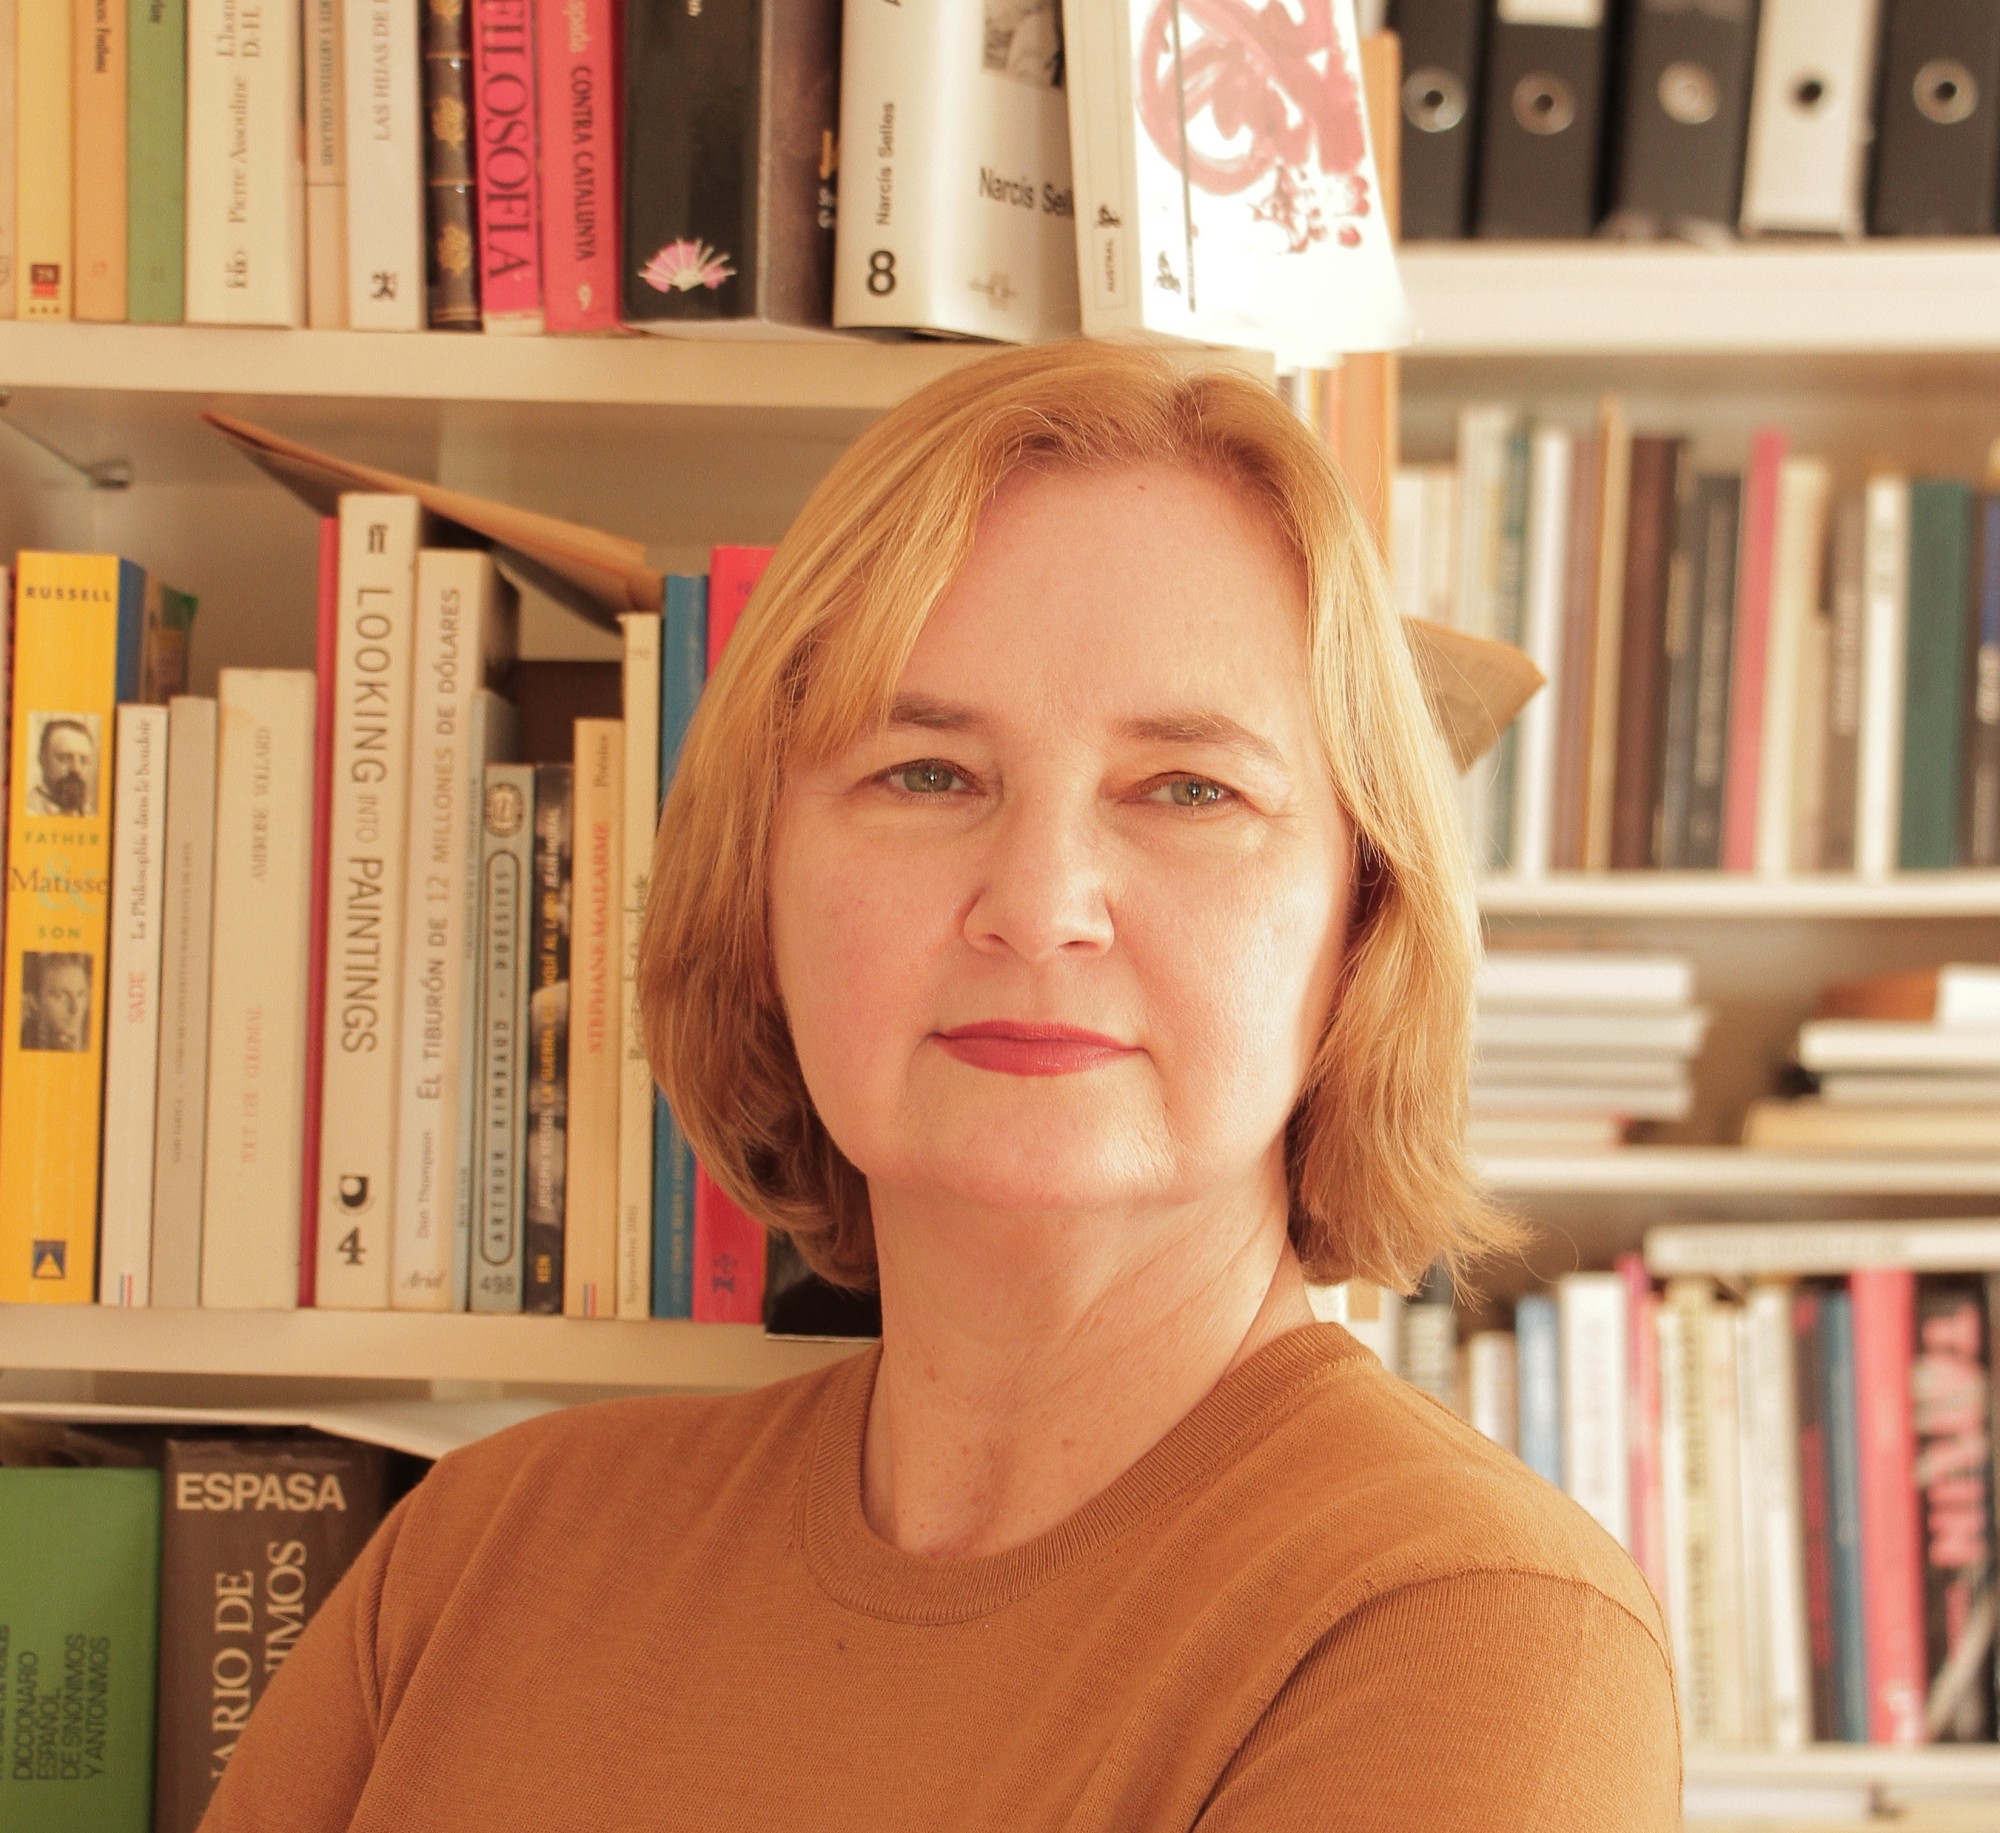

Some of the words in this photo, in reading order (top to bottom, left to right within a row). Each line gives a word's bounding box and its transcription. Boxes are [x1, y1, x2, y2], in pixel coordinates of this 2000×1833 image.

[371, 9, 389, 37] DE
[372, 44, 390, 98] HIJAS
[373, 105, 391, 141] LAS
[571, 65, 594, 145] CONTRA
[480, 0, 532, 278] FILOSOFIA
[227, 169, 249, 224] Pierre
[572, 152, 598, 262] CATALUNYA
[867, 248, 896, 296] 8
[25, 586, 113, 603] RUSSELL
[432, 588, 461, 694] DÓLARES
[353, 588, 392, 784] LOOKING
[436, 705, 457, 736] DE
[133, 718, 152, 777] boudoir
[132, 796, 150, 830] dans
[357, 794, 380, 844] INTO
[431, 747, 455, 863] MILLONES
[24, 831, 100, 846] FATHER
[10, 865, 107, 896] Matisse
[129, 834, 153, 917] Philosophie
[425, 875, 450, 903] 12
[544, 853, 561, 888] JEAN
[37, 926, 81, 939] SON
[129, 921, 147, 941] La
[341, 856, 384, 1053] PAINTINGS
[425, 917, 449, 947] DE
[542, 932, 558, 951] AL
[126, 969, 147, 1025] SADE
[419, 957, 445, 1061] TIBURÓN
[492, 1019, 509, 1129] RIMBAUD
[540, 1026, 556, 1081] GUERRA
[540, 1084, 555, 1104] LA
[418, 1130, 437, 1205] Thompson
[490, 1150, 507, 1244] ARTHUR
[337, 1226, 367, 1266] 4
[416, 1209, 431, 1239] Don
[536, 1254, 552, 1284] KEN
[176, 1472, 347, 1512] ESPASA
[215, 1569, 255, 1634] DE
[264, 1540, 308, 1673] IMOS
[12, 1650, 38, 1781] DICCIONARIO
[210, 1647, 254, 1779] ARIO
[60, 1751, 82, 1781] DE
[84, 1763, 104, 1781] Y
